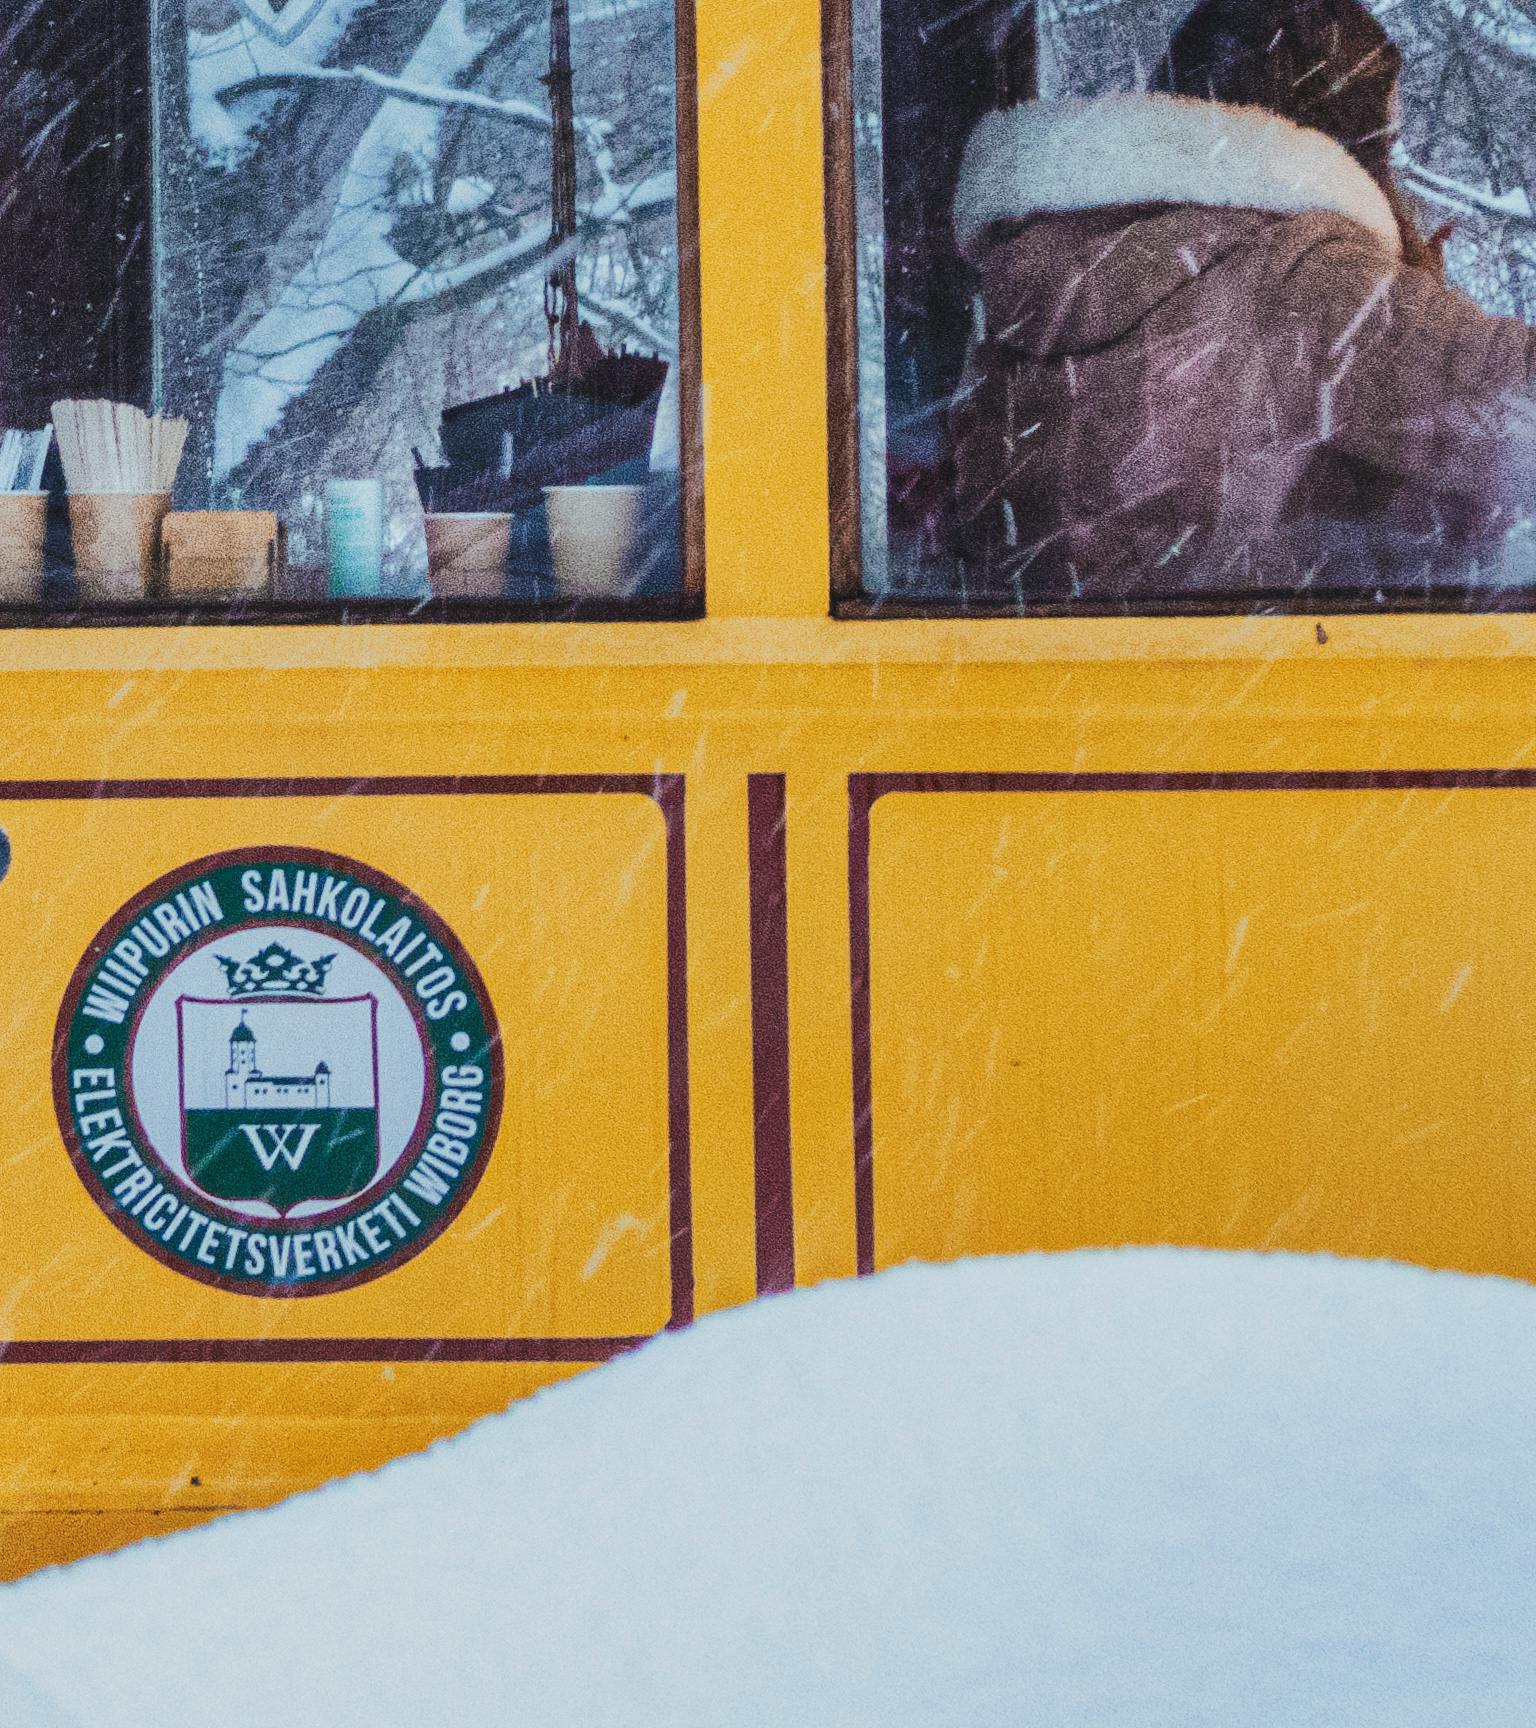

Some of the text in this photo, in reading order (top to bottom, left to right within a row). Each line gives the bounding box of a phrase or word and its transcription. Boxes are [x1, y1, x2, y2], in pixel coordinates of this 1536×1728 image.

[81, 880, 225, 1025] WIIPURIN
[239, 1123, 322, 1172] W
[402, 1064, 485, 1207] WIBORG
